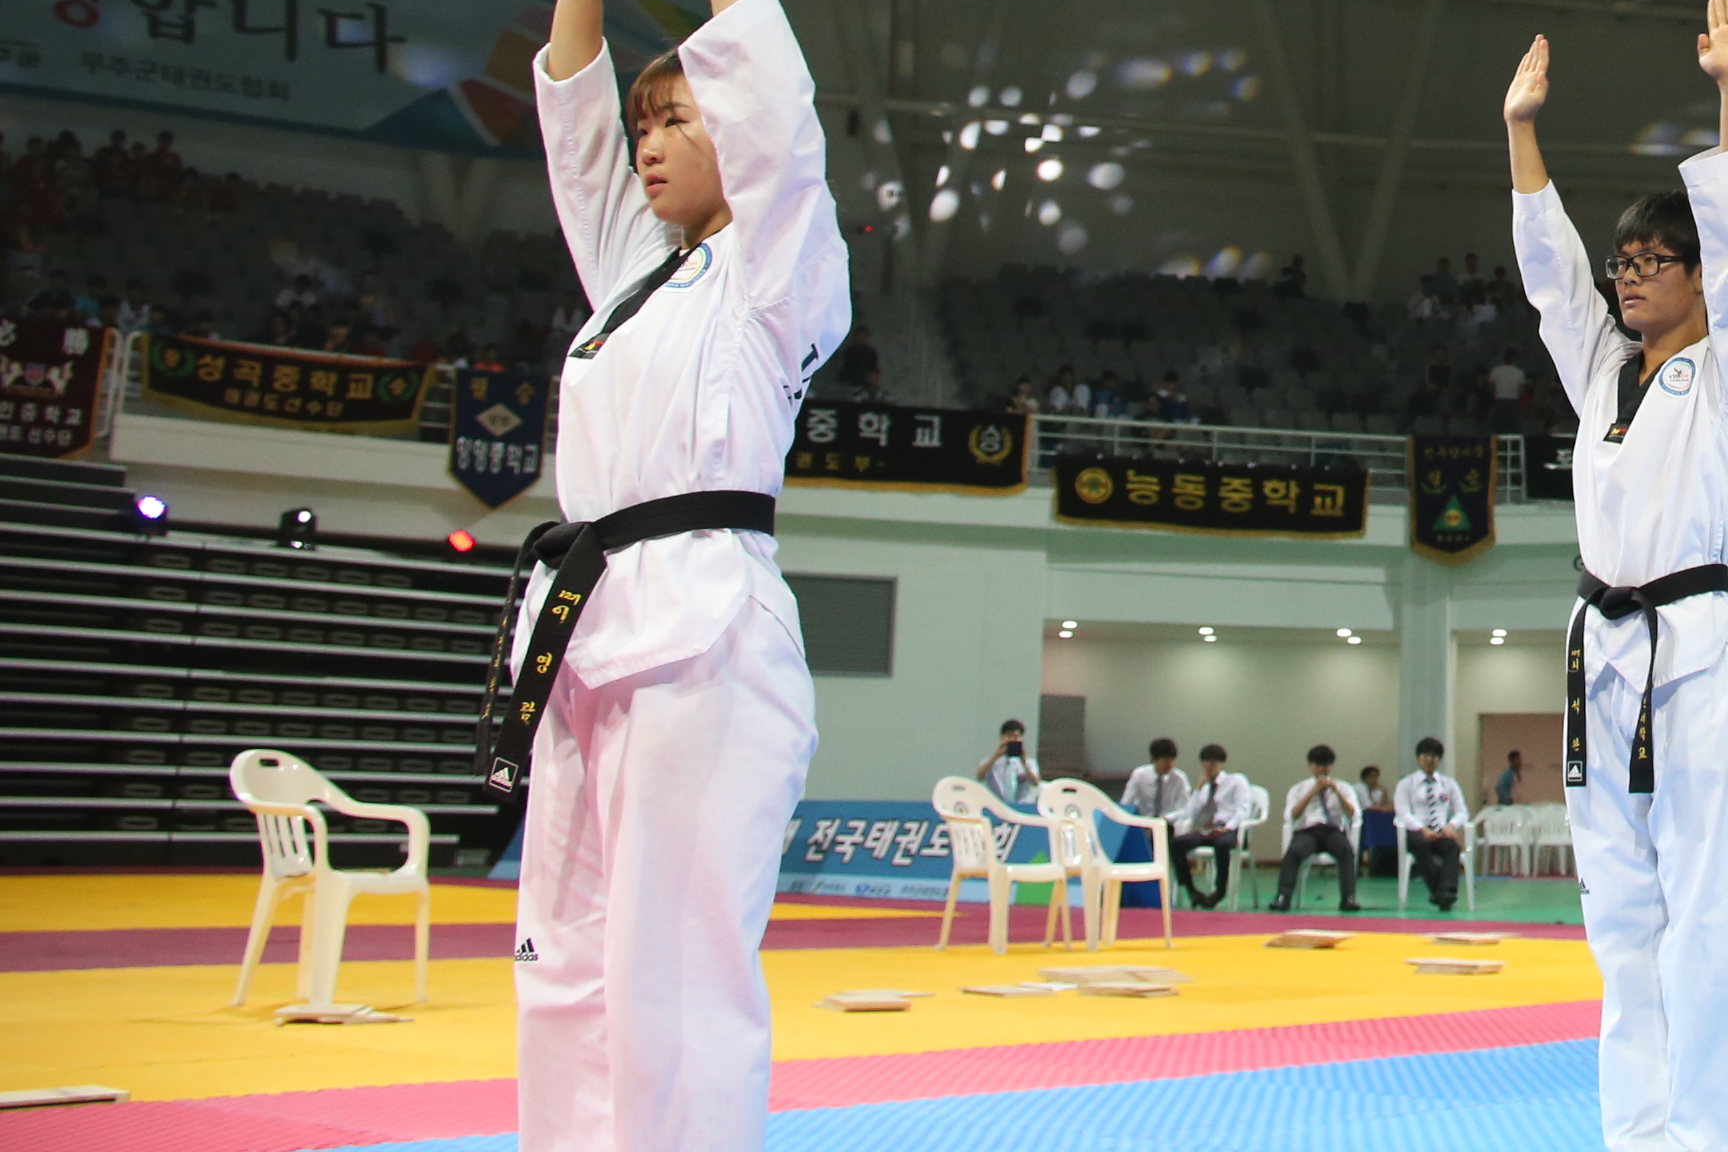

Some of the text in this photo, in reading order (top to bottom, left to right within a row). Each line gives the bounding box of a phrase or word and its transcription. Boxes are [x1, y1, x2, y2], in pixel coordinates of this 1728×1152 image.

[806, 408, 942, 447] 중학교
[1125, 469, 1345, 517] 능동중학교
[804, 817, 1022, 866] 전국태권도회
